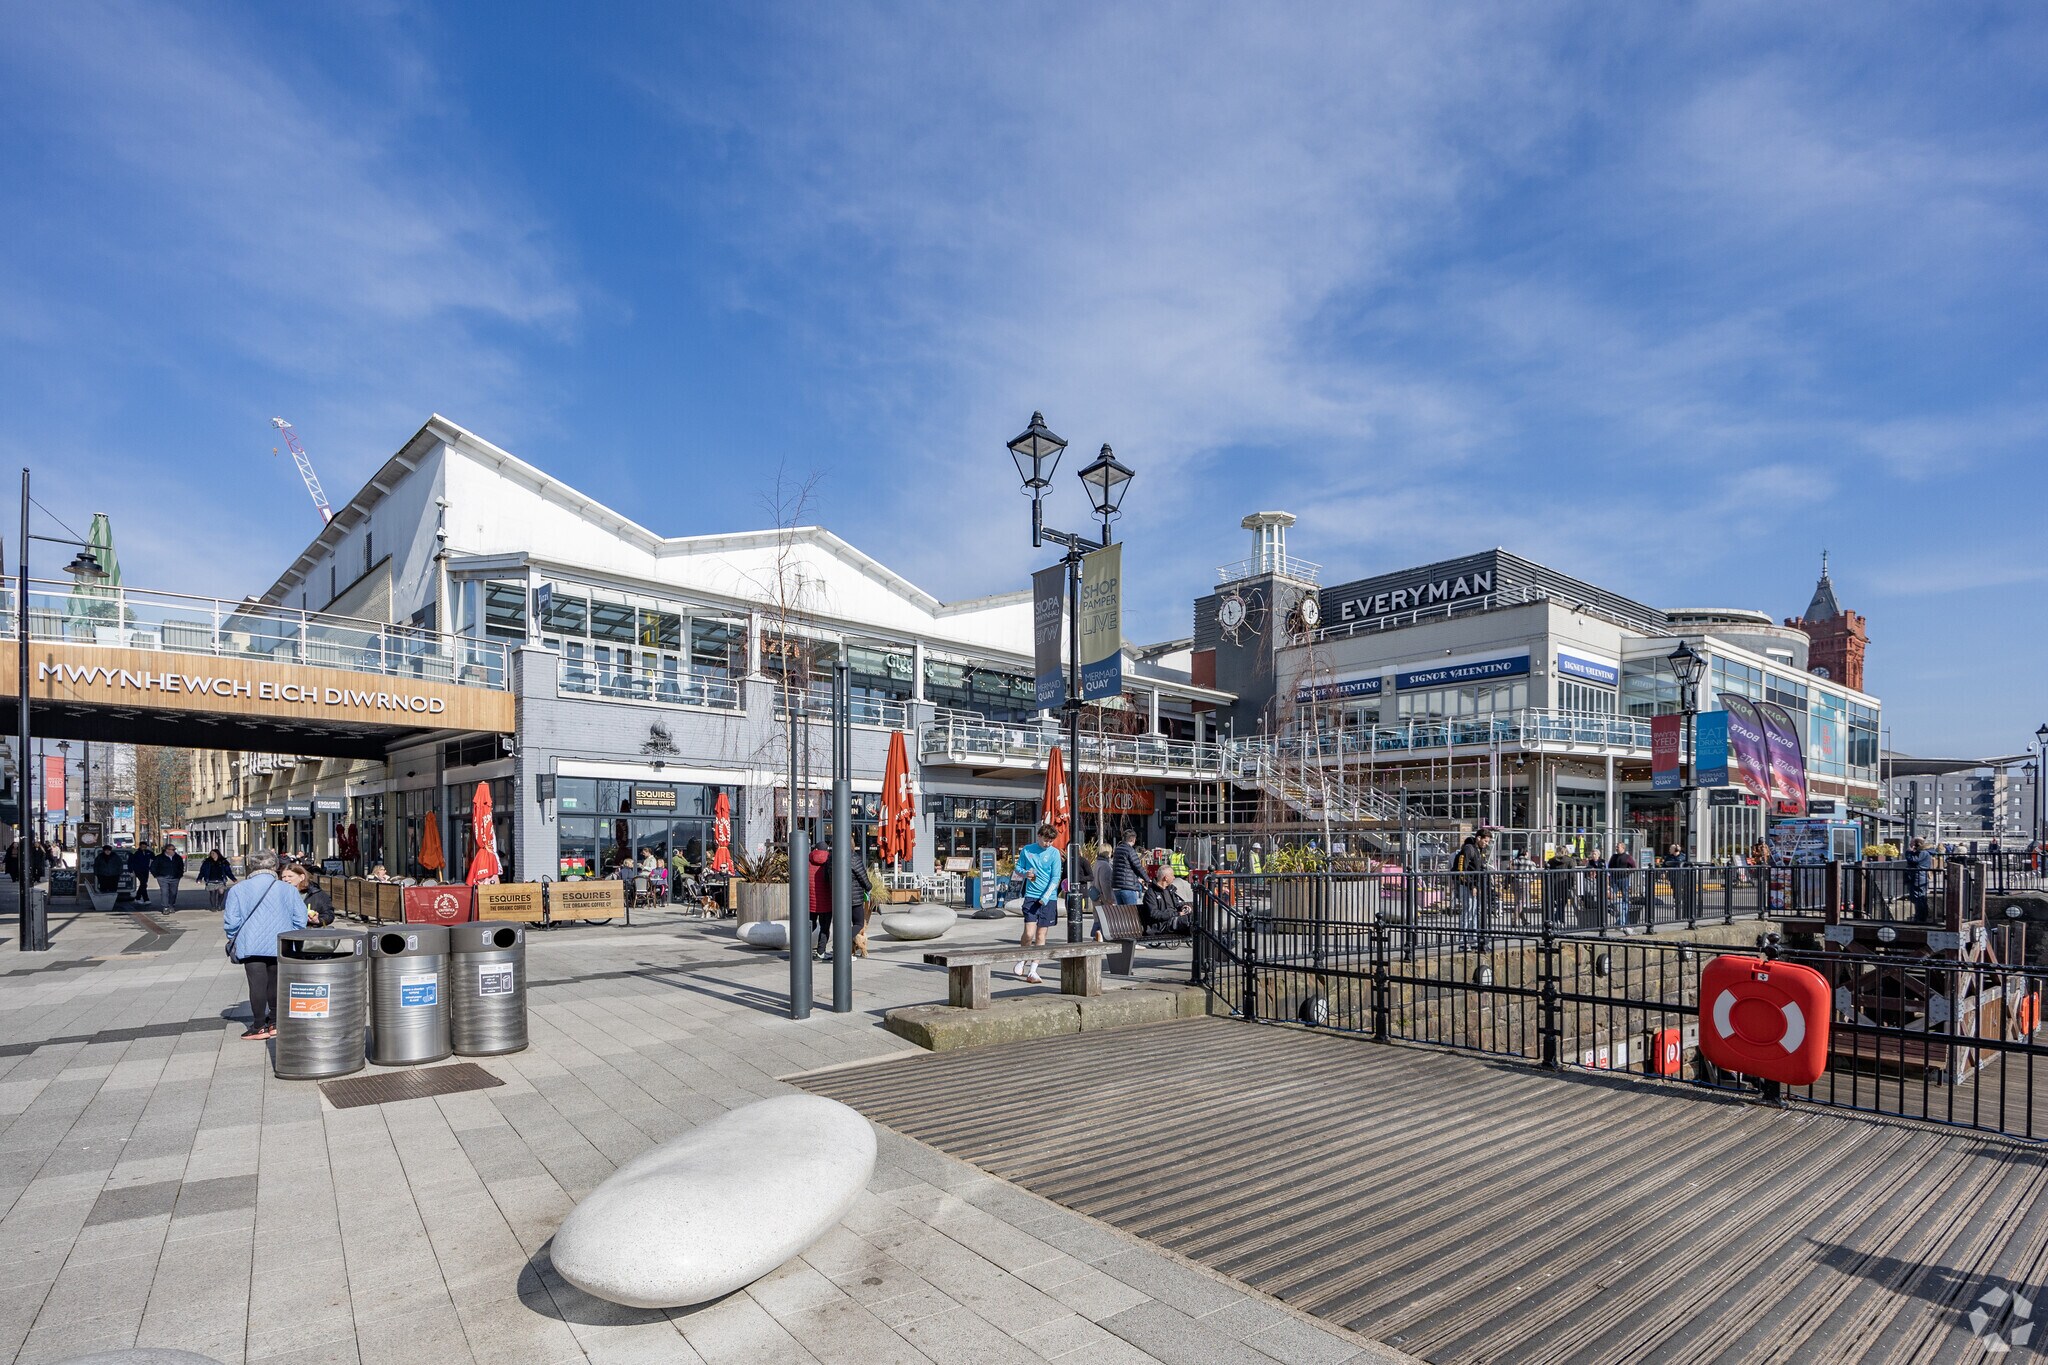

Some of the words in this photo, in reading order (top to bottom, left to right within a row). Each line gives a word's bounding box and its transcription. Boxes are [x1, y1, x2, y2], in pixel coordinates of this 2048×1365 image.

[1083, 578, 1117, 600] SHOP
[1341, 571, 1491, 621] EVERYMAN
[1035, 596, 1059, 615] SIOPA
[1083, 595, 1117, 611] PAMPER
[1083, 611, 1118, 635] LIVE
[1084, 668, 1118, 682] MERMAID
[1409, 671, 1447, 683] SIGNOR
[1450, 662, 1512, 678] VALENTINO
[1564, 660, 1585, 673] SIGNOR
[1585, 666, 1615, 681] VALENTINO
[38, 661, 252, 698] MWYNHEWCH
[259, 681, 317, 704] EICH
[325, 687, 446, 713] DIWRNOD
[1037, 680, 1061, 692] MERMAID
[1085, 679, 1109, 692] QUAY
[1037, 690, 1055, 702] QUAY
[1699, 727, 1724, 740] EAT
[1654, 738, 1676, 746] YFED
[636, 790, 675, 799] ESQUIRES
[489, 894, 532, 903] ESQUIRES
[562, 891, 611, 900] ESQUIRES
